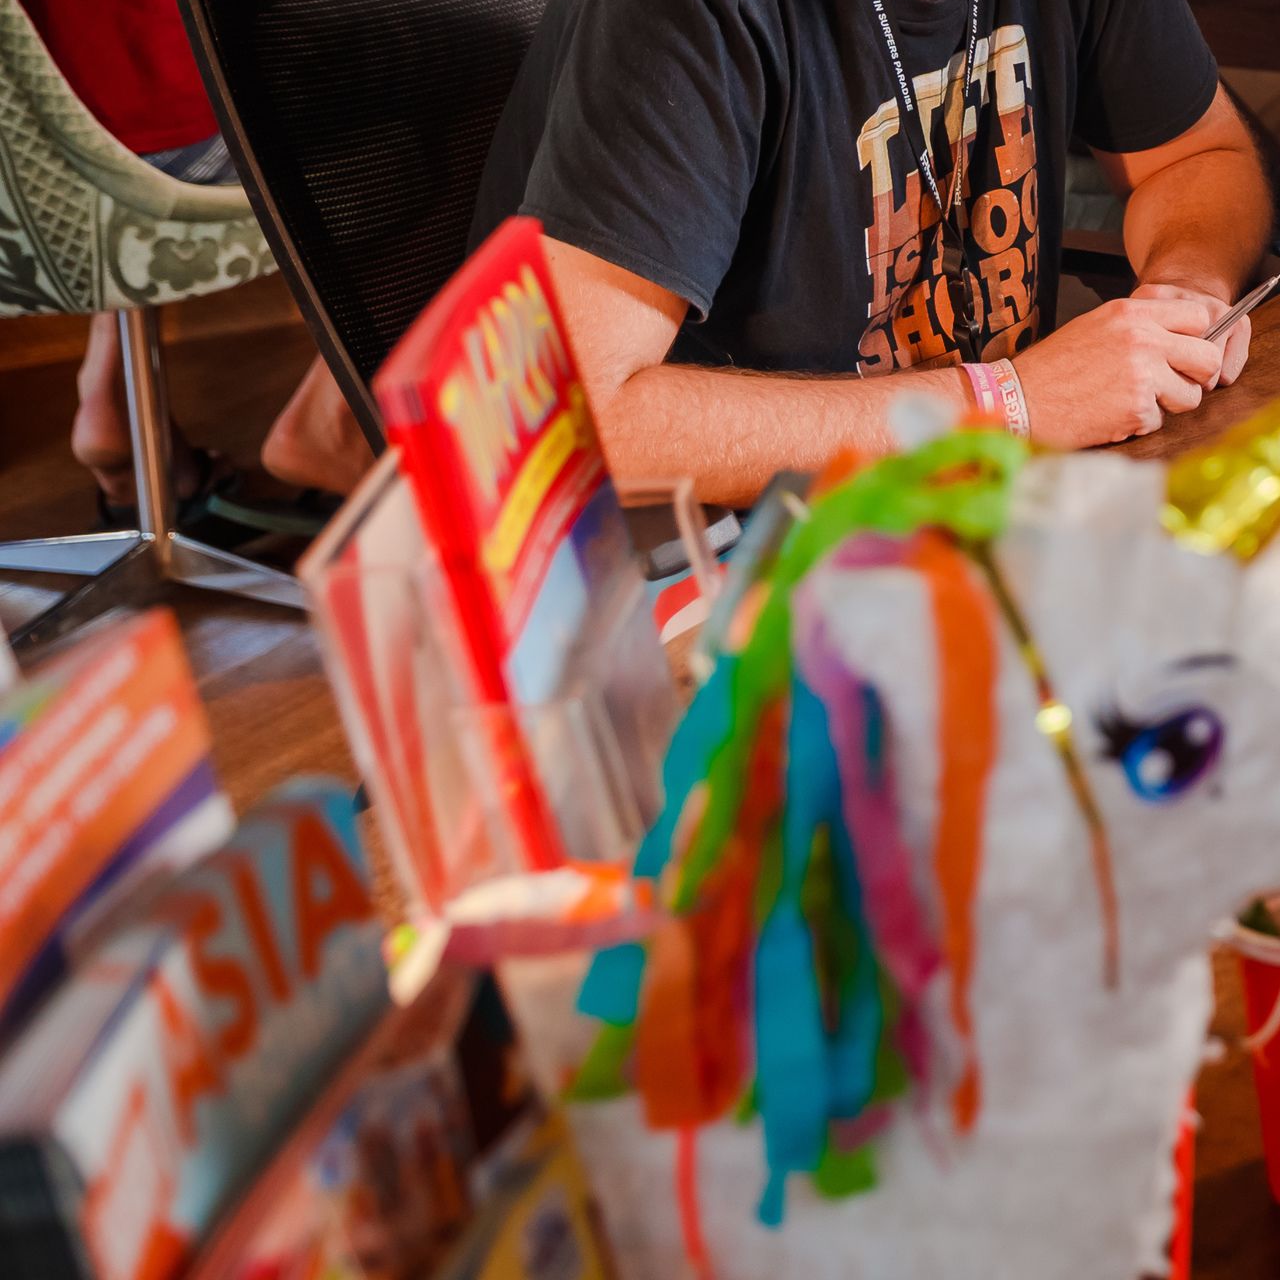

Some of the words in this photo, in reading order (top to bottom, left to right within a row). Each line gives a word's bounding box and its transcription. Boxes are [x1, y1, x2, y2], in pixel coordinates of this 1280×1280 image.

[972, 4, 978, 13] IN
[972, 20, 978, 35] US
[878, 12, 899, 60] SURFERS
[893, 59, 913, 112] PARADISE
